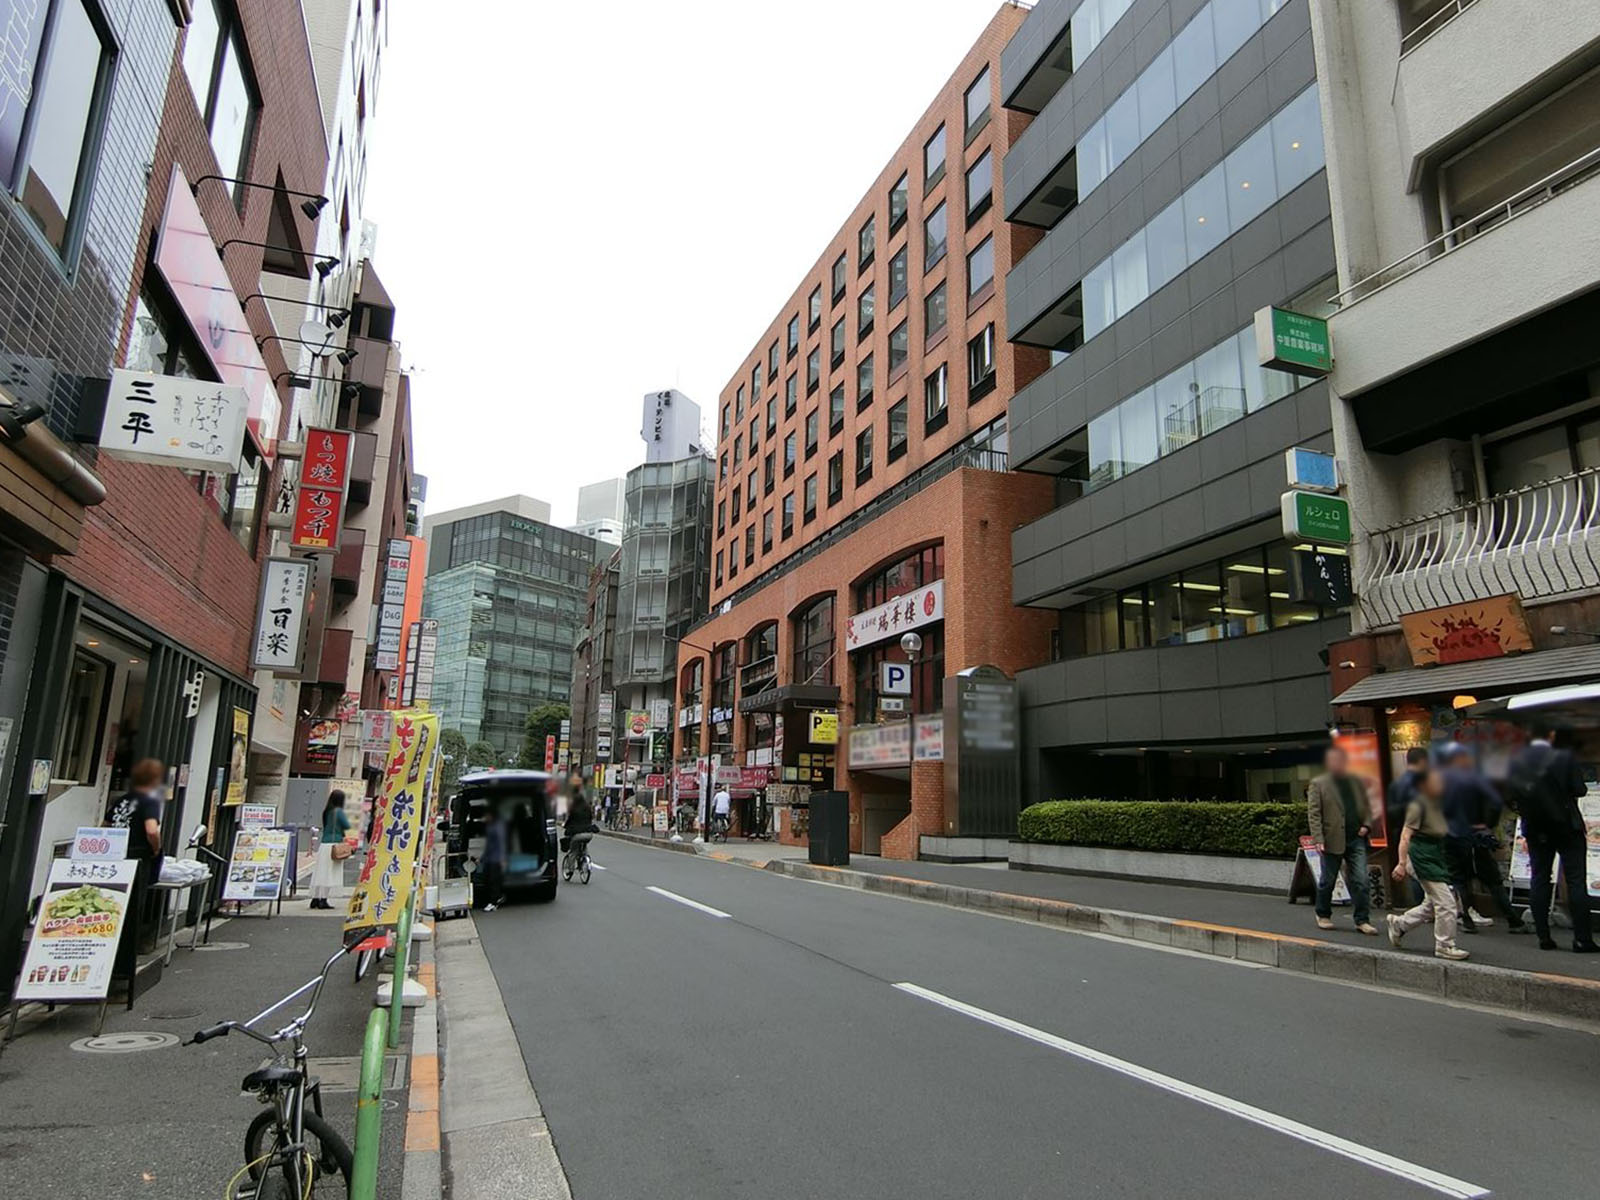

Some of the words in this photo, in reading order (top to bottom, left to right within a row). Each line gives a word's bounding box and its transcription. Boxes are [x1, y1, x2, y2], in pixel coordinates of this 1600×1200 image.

[121, 381, 157, 444] 三平
[888, 666, 905, 689] P
[813, 716, 823, 729] P
